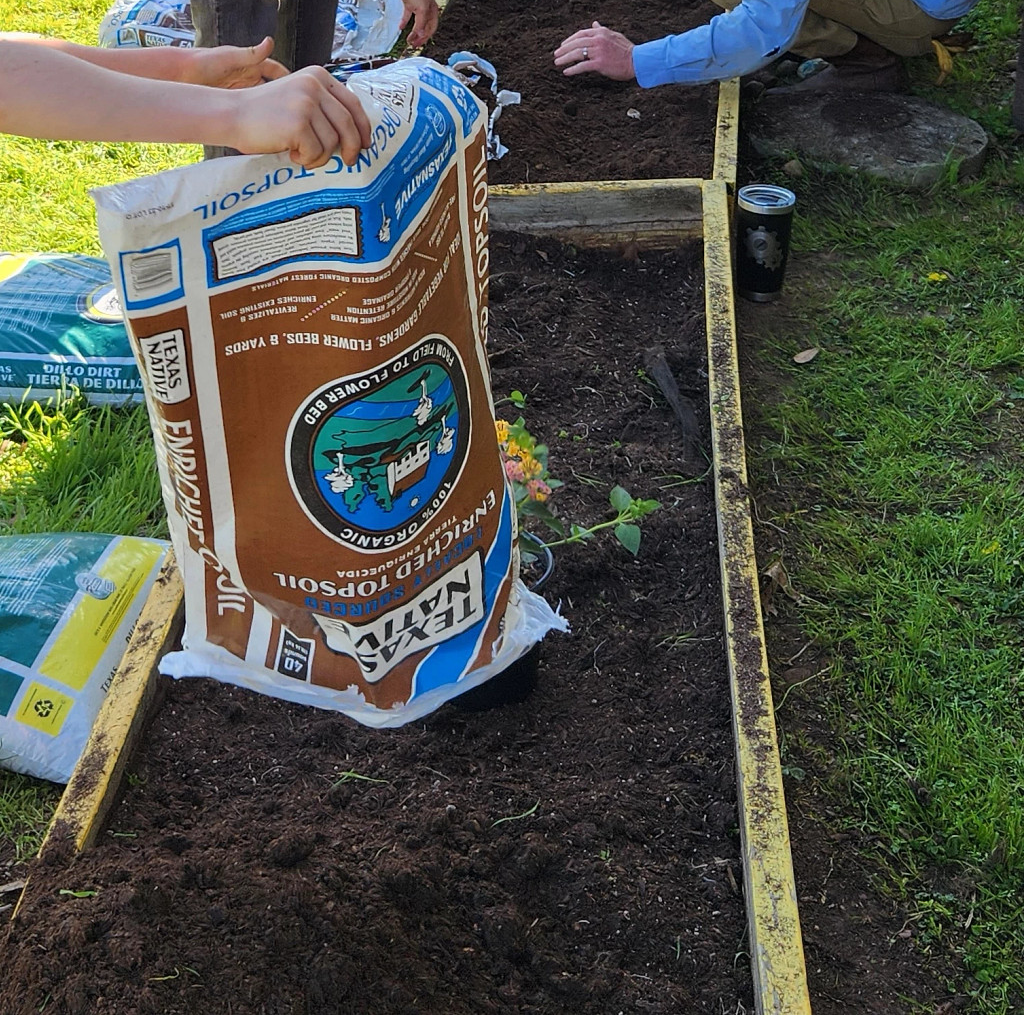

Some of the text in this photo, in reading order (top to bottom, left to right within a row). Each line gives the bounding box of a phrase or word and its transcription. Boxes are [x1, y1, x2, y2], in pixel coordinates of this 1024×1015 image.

[194, 165, 314, 220] TOPSOIL
[252, 276, 289, 292] MATERIALS
[291, 273, 317, 282] FOREST
[319, 274, 350, 283] ORGANIC
[352, 270, 392, 284] COMPOSTED
[362, 288, 395, 306] DRAINAGE
[418, 267, 444, 316] VEGETABLE
[219, 295, 317, 320] ENRICHES EXISTING SOIL
[248, 305, 298, 321] REVITALIZES
[346, 304, 386, 315] RETENTION
[330, 313, 359, 324] MATTER
[360, 313, 391, 324] ORGANIC
[225, 336, 266, 356] YARDS
[323, 335, 372, 351] FLOWER
[147, 342, 169, 400] NATIVE
[163, 336, 182, 389] TEXAS
[87, 366, 122, 378] DIRT
[83, 377, 102, 388] DE
[303, 343, 455, 425] FROM FIELD TO FLOWER BED
[339, 482, 453, 548] 100% ORGANIC
[273, 489, 497, 598] ENRICHED TOPSOIL
[337, 515, 458, 578] TIERRA ENRIQUECIDA
[304, 585, 405, 617] SOURCED
[357, 597, 477, 673] TEXAS
[283, 657, 304, 673] 40
